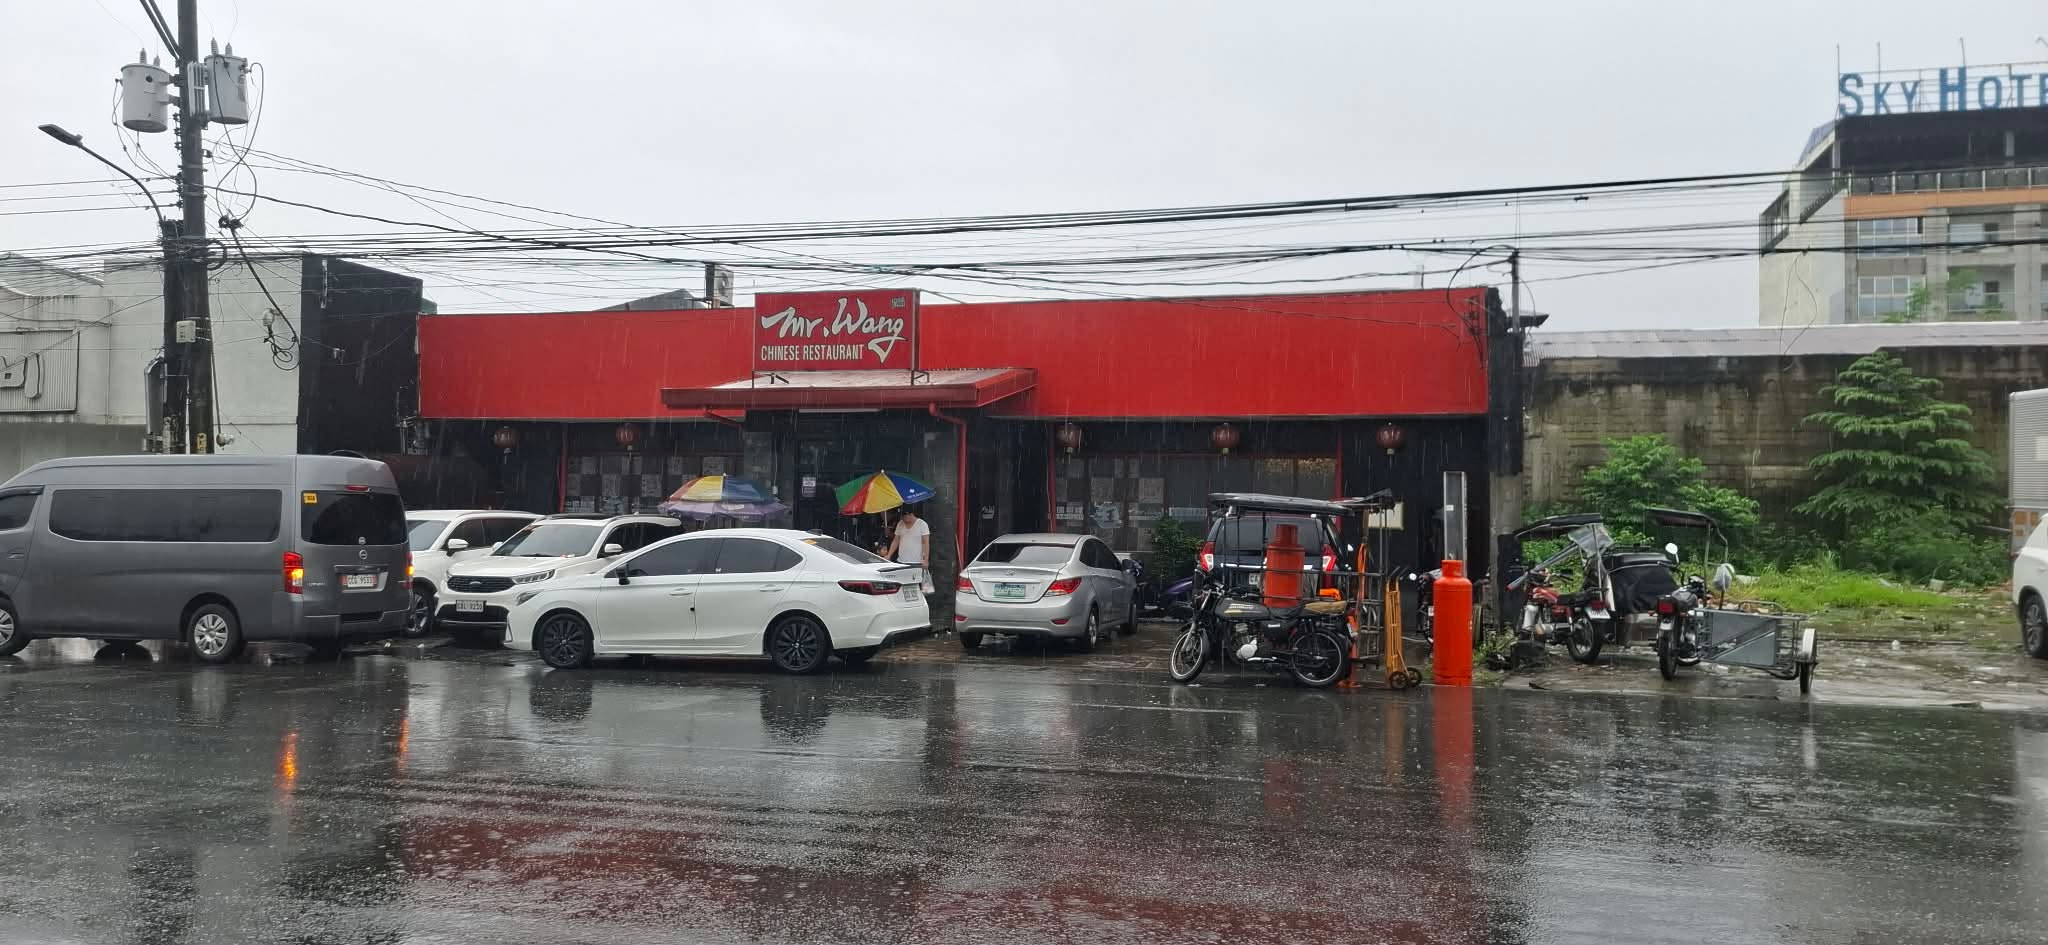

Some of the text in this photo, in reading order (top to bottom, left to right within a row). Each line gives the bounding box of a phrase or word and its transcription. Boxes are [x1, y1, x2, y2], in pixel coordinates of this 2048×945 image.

[1839, 73, 1920, 117] SKY
[761, 297, 908, 364] Mr. Wang
[761, 344, 865, 361] CHINESE RESTAURANT
